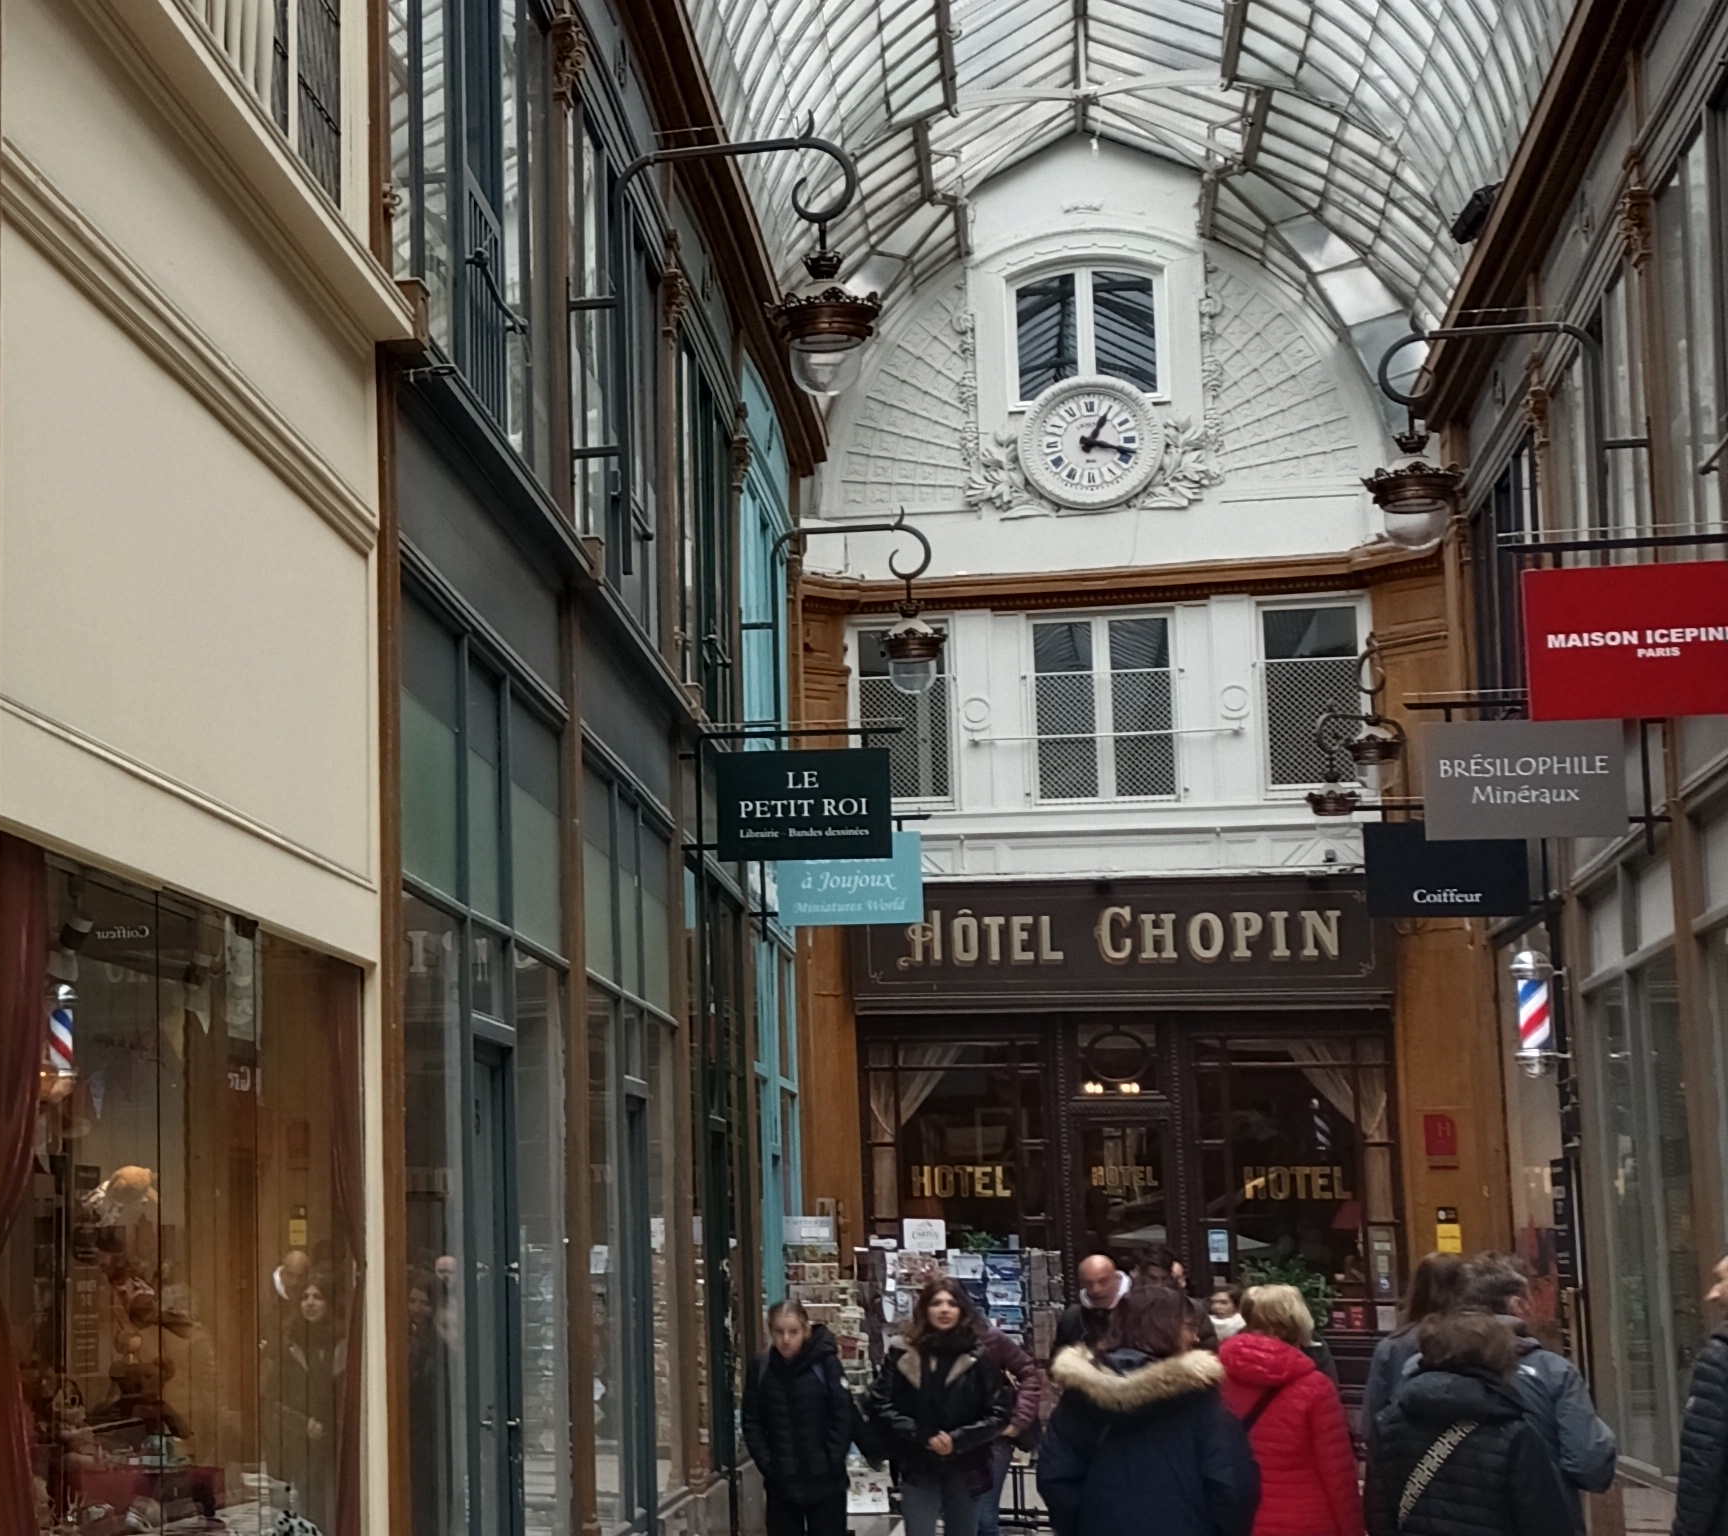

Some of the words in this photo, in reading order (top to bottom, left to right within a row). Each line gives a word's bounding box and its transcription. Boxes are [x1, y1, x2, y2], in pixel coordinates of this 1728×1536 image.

[1547, 631, 1638, 648] MAISON
[1637, 647, 1681, 658] PARIS
[1439, 754, 1609, 778] BRÉSILOPHILE
[786, 771, 819, 789] LE
[1472, 785, 1580, 804] Minéraux
[739, 799, 815, 818] PETIT
[822, 798, 869, 815] ROI
[740, 828, 779, 839] Librairie
[788, 827, 823, 837] Bandes
[801, 872, 813, 889] à
[817, 872, 897, 894] Joujoux
[794, 901, 862, 913] Miniatures
[865, 898, 908, 911] World
[1412, 889, 1483, 904] Coiffeur
[897, 909, 1064, 968] HÔTEL
[1094, 906, 1342, 963] CHOPIN
[912, 1164, 1012, 1198] HOTEL
[1091, 1166, 1159, 1187] HOTEL
[1243, 1166, 1352, 1200] HOTEL
